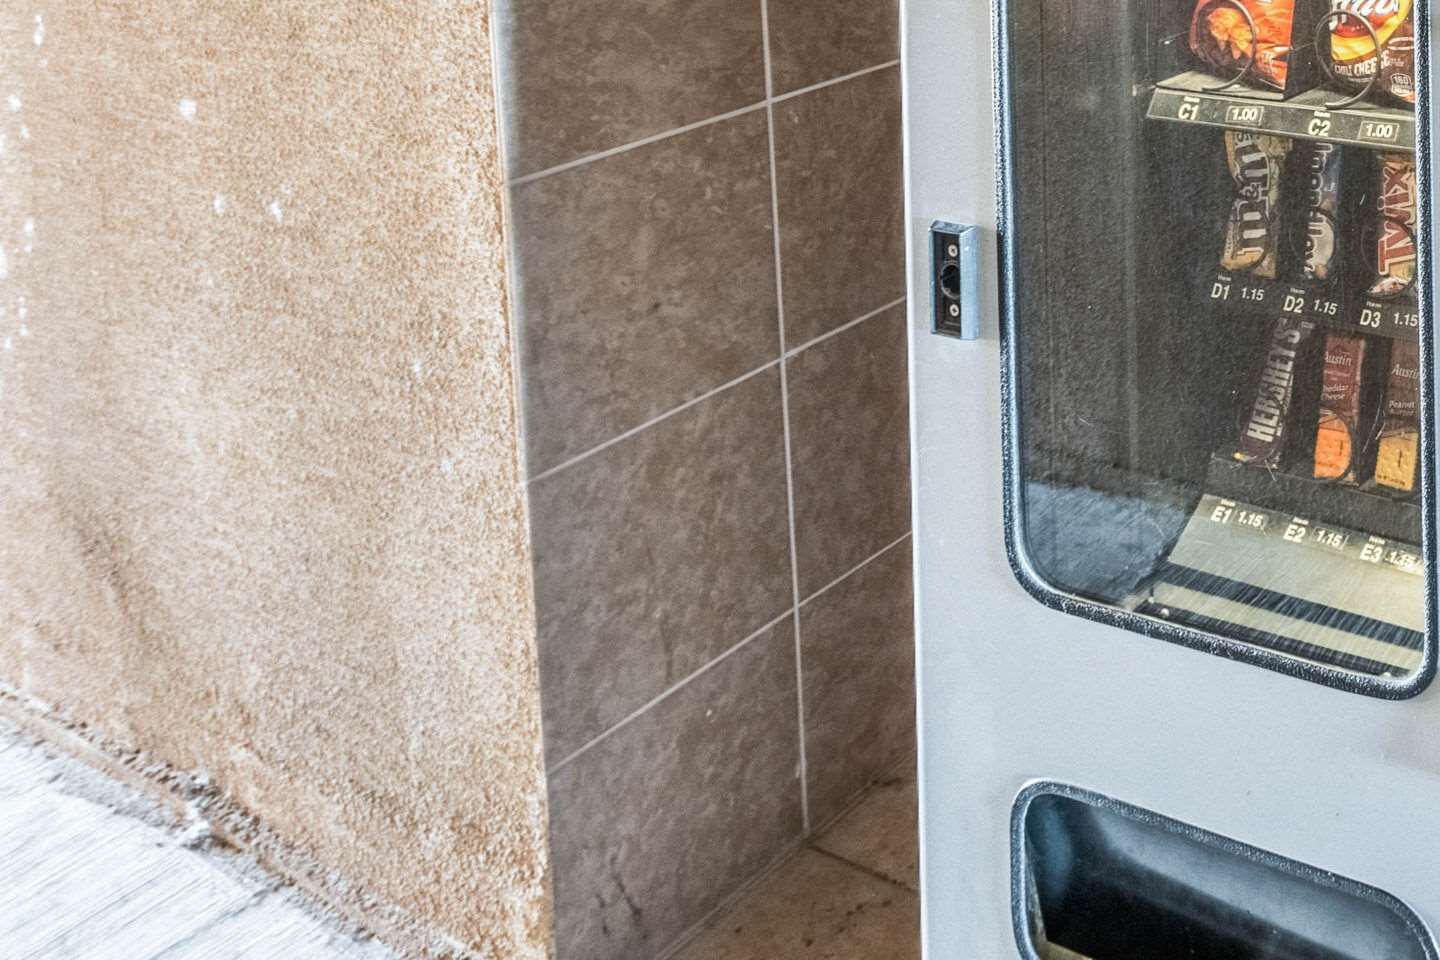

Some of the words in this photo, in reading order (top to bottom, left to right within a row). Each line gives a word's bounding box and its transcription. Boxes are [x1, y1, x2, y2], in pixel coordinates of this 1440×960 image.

[1178, 103, 1198, 120] C1
[1231, 109, 1257, 122] 1.00
[1308, 118, 1330, 136] C2
[1366, 123, 1393, 138] 1.00
[1211, 283, 1230, 300] D1
[1241, 288, 1264, 301] 1.15
[1283, 295, 1304, 313] D2
[1313, 299, 1337, 315] 1.15
[1360, 309, 1381, 328] D3
[1393, 313, 1419, 327] 1.15
[1211, 505, 1232, 524] E1
[1238, 511, 1263, 527] 1.15
[1283, 524, 1306, 542] E2
[1317, 530, 1343, 547] 1.15
[1360, 543, 1383, 563] E3
